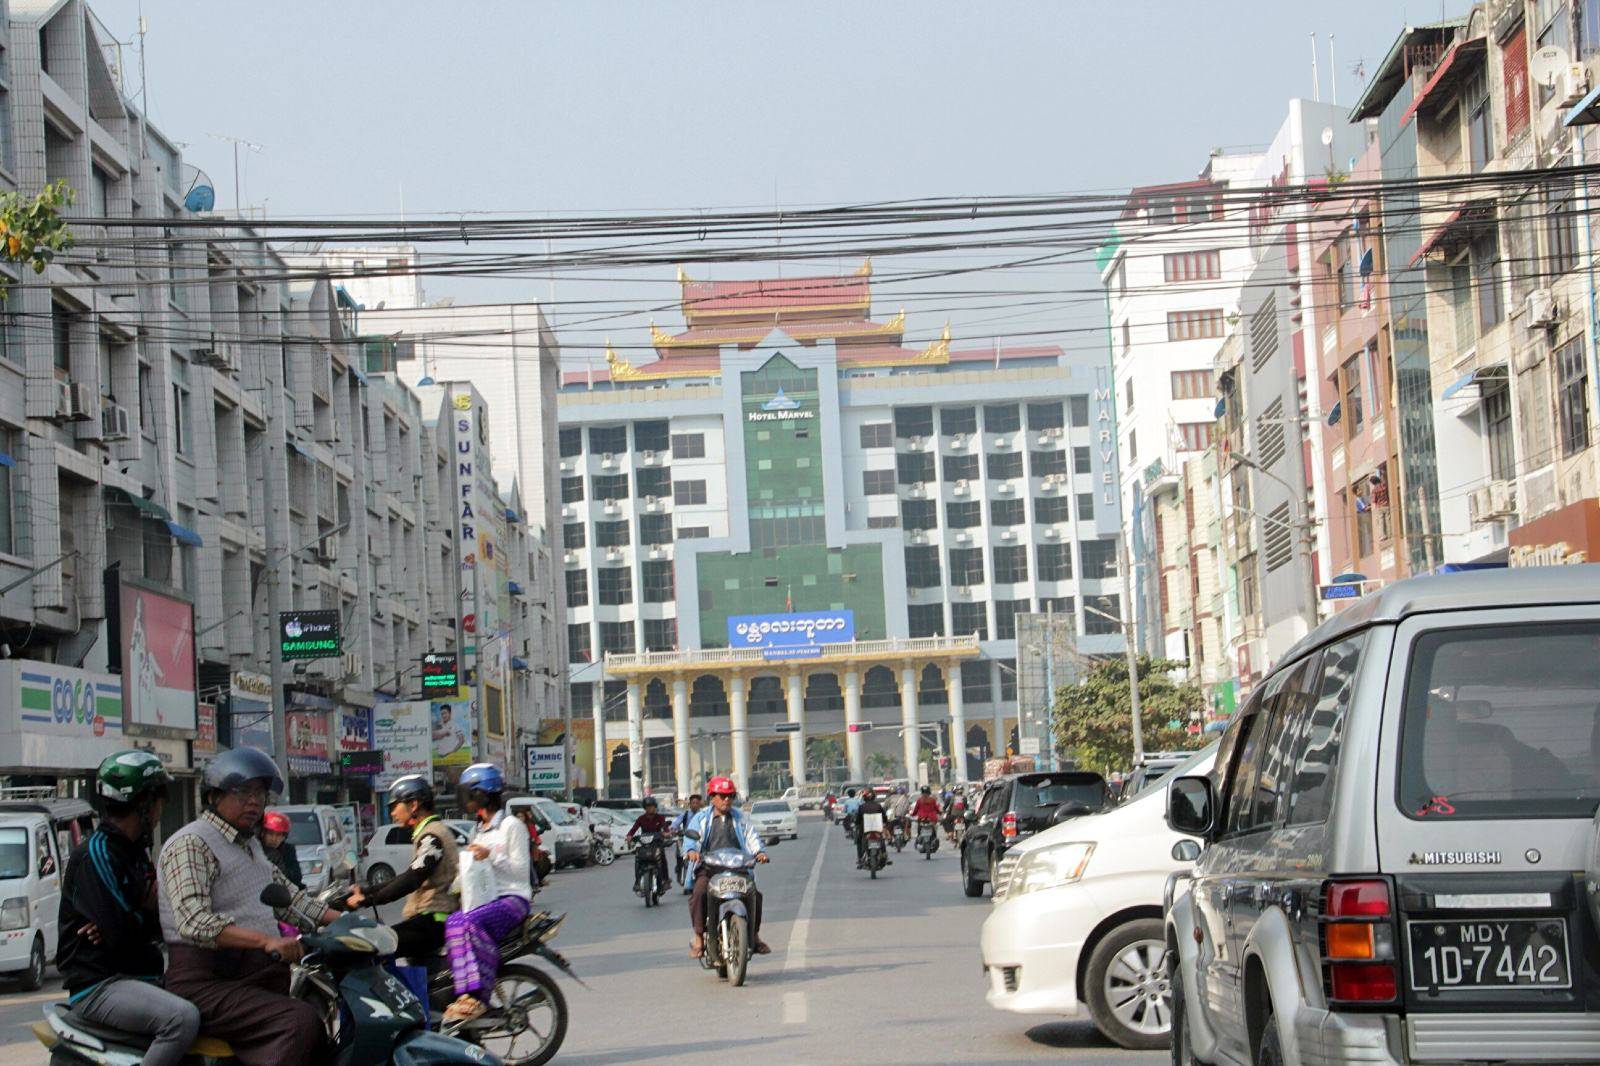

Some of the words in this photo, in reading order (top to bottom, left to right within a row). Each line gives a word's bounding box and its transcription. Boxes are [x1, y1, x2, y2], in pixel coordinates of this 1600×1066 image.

[748, 412, 777, 421] HOTEL
[778, 410, 814, 419] MARVEL
[1094, 388, 1114, 505] MARVEL
[458, 419, 475, 540] SUNFAR
[1424, 851, 1501, 865] MITSUBISHI
[1460, 923, 1509, 943] MDY
[1424, 944, 1560, 985] 1D-7442
